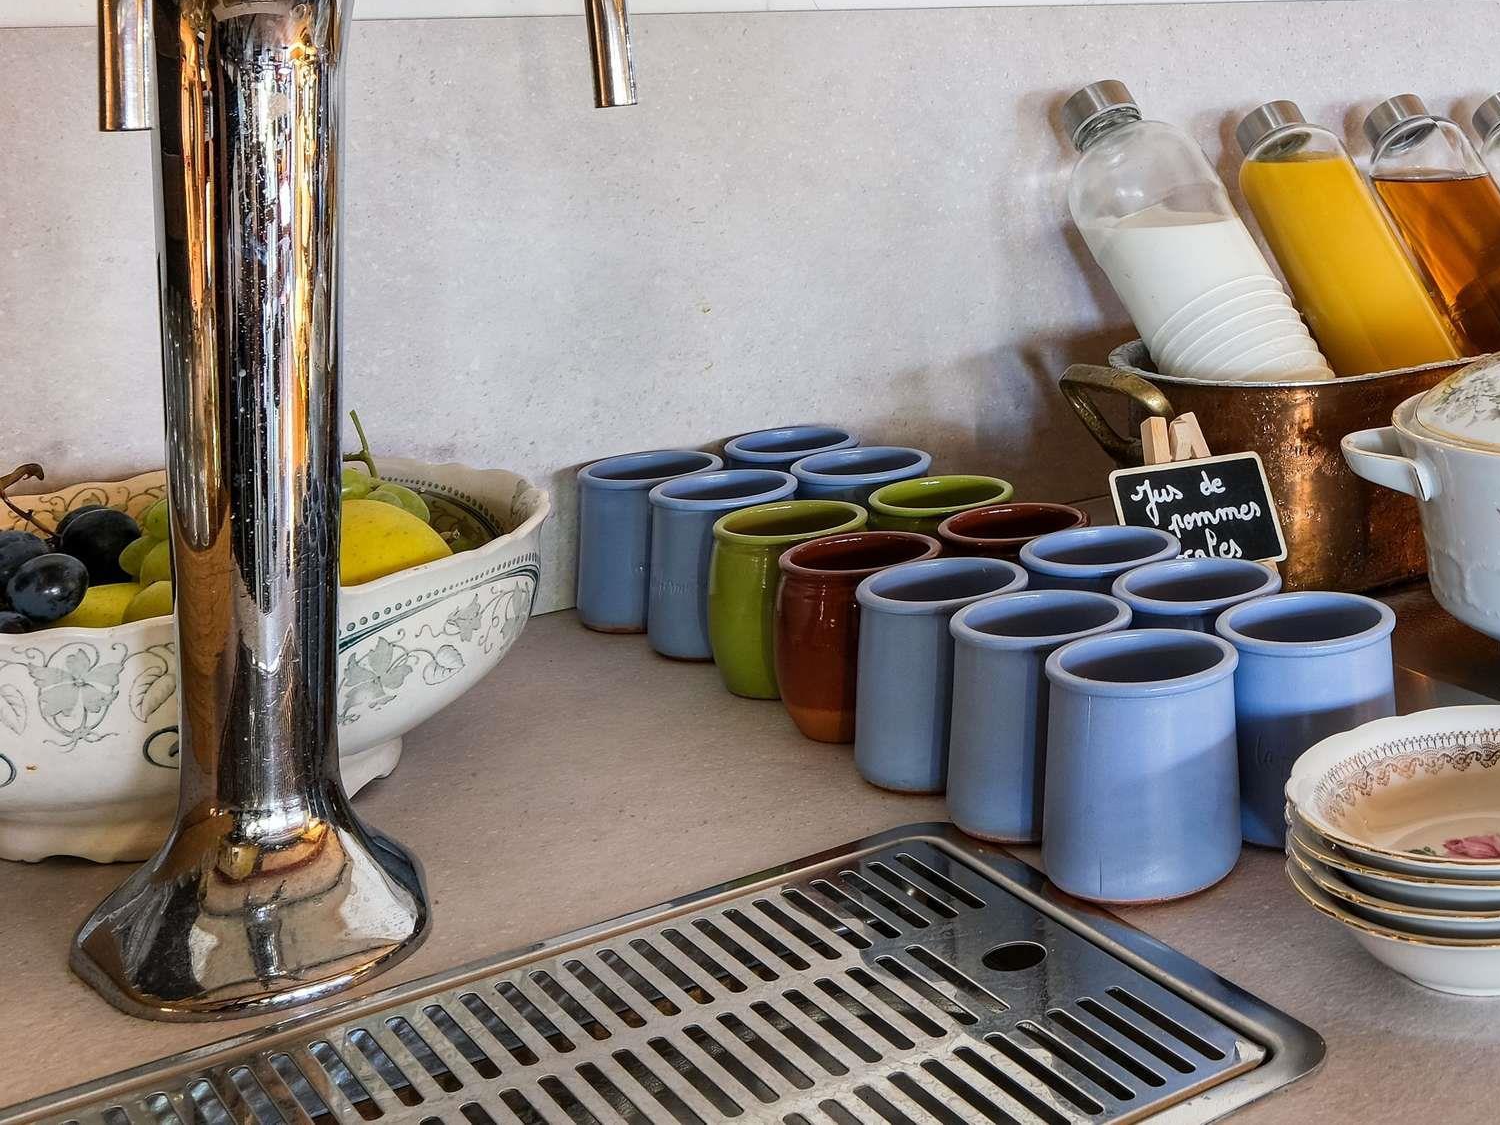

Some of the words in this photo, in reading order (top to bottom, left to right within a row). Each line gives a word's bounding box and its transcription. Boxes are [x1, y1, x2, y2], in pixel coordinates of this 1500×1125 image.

[1130, 479, 1184, 526] Jus
[1200, 470, 1226, 496] de
[1168, 501, 1261, 538] pommes
